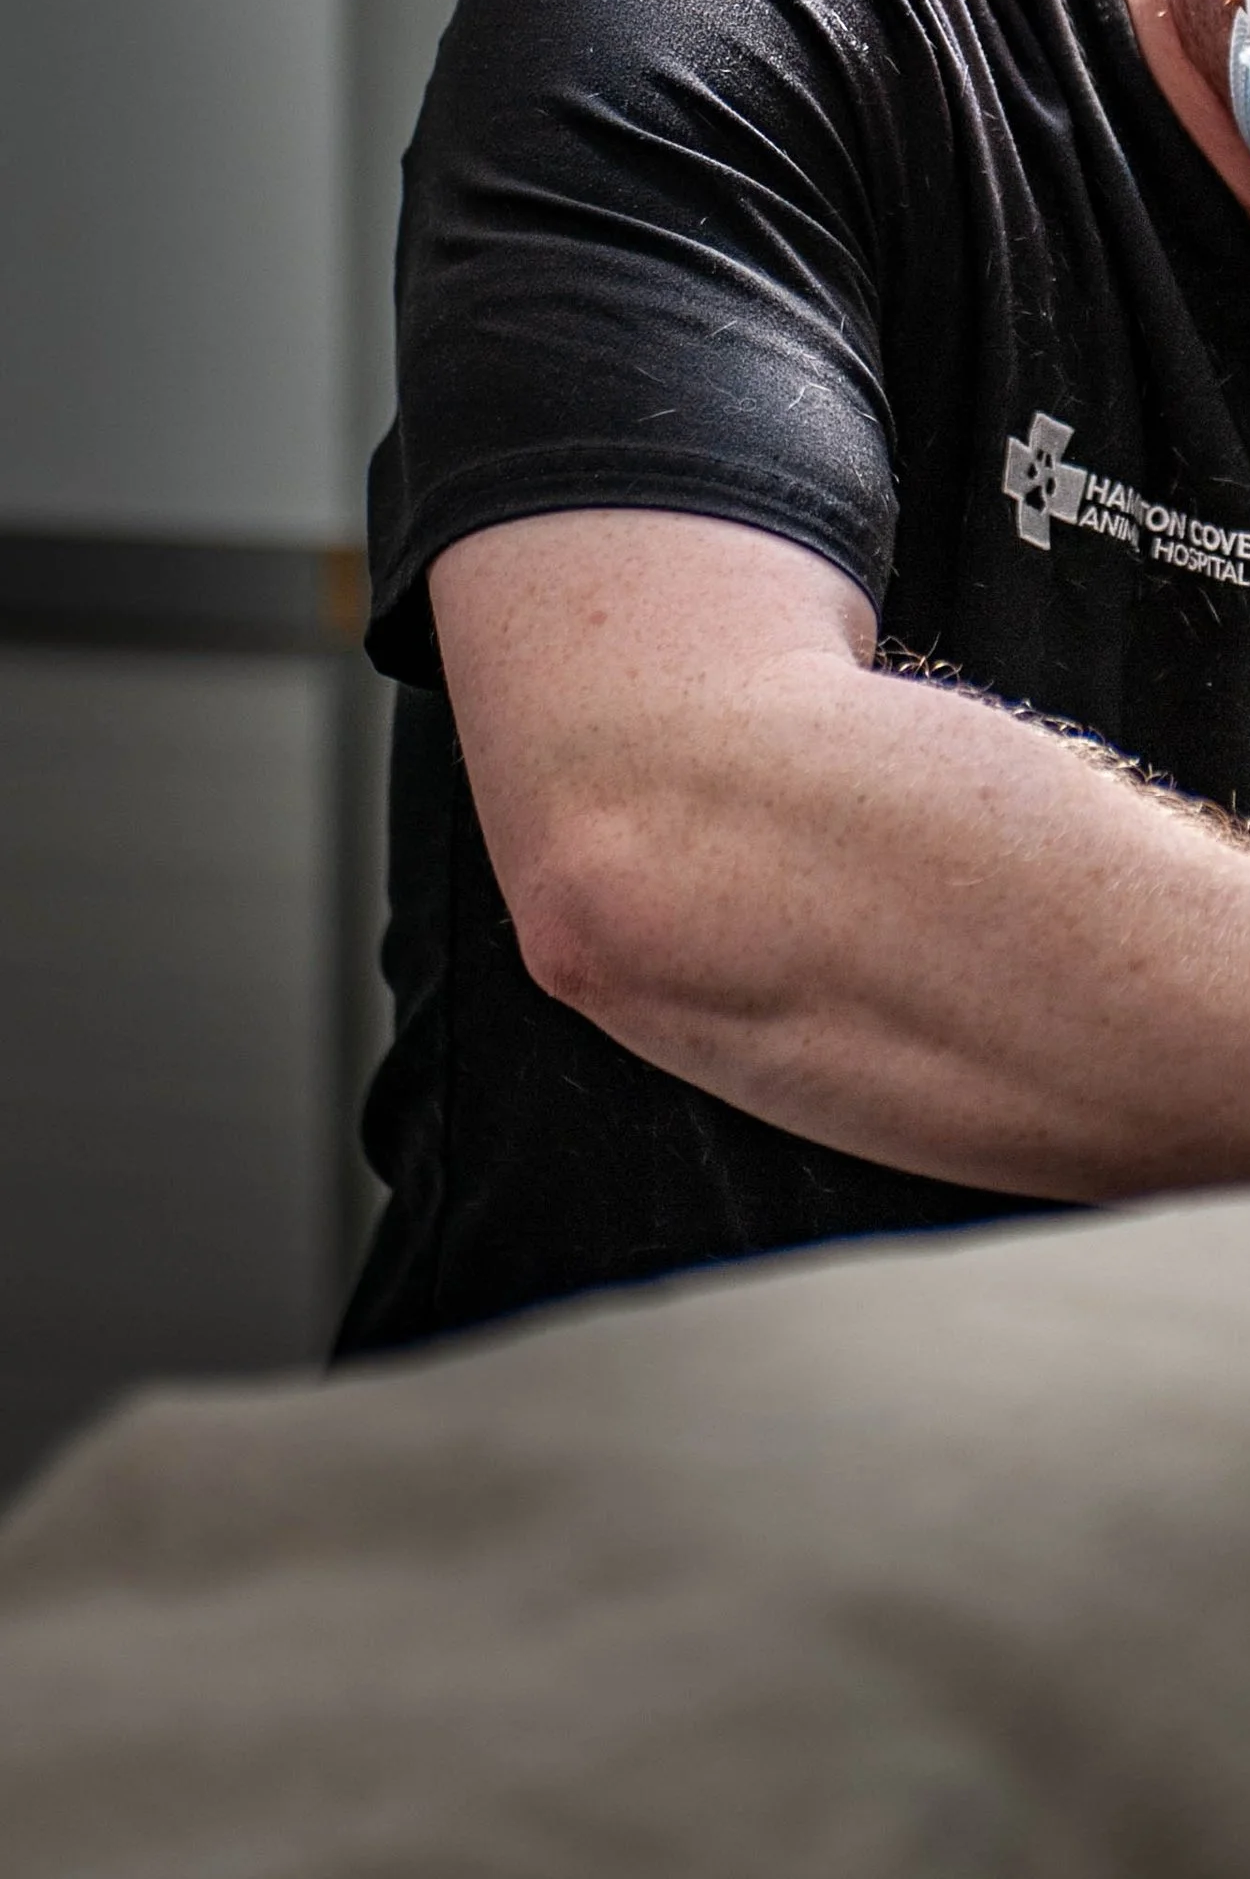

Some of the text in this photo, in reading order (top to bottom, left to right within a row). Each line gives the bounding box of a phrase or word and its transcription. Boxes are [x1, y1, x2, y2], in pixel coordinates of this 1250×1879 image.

[1086, 474, 1187, 539] HATON
[1079, 506, 1250, 588] ANIM HOSPITAL
